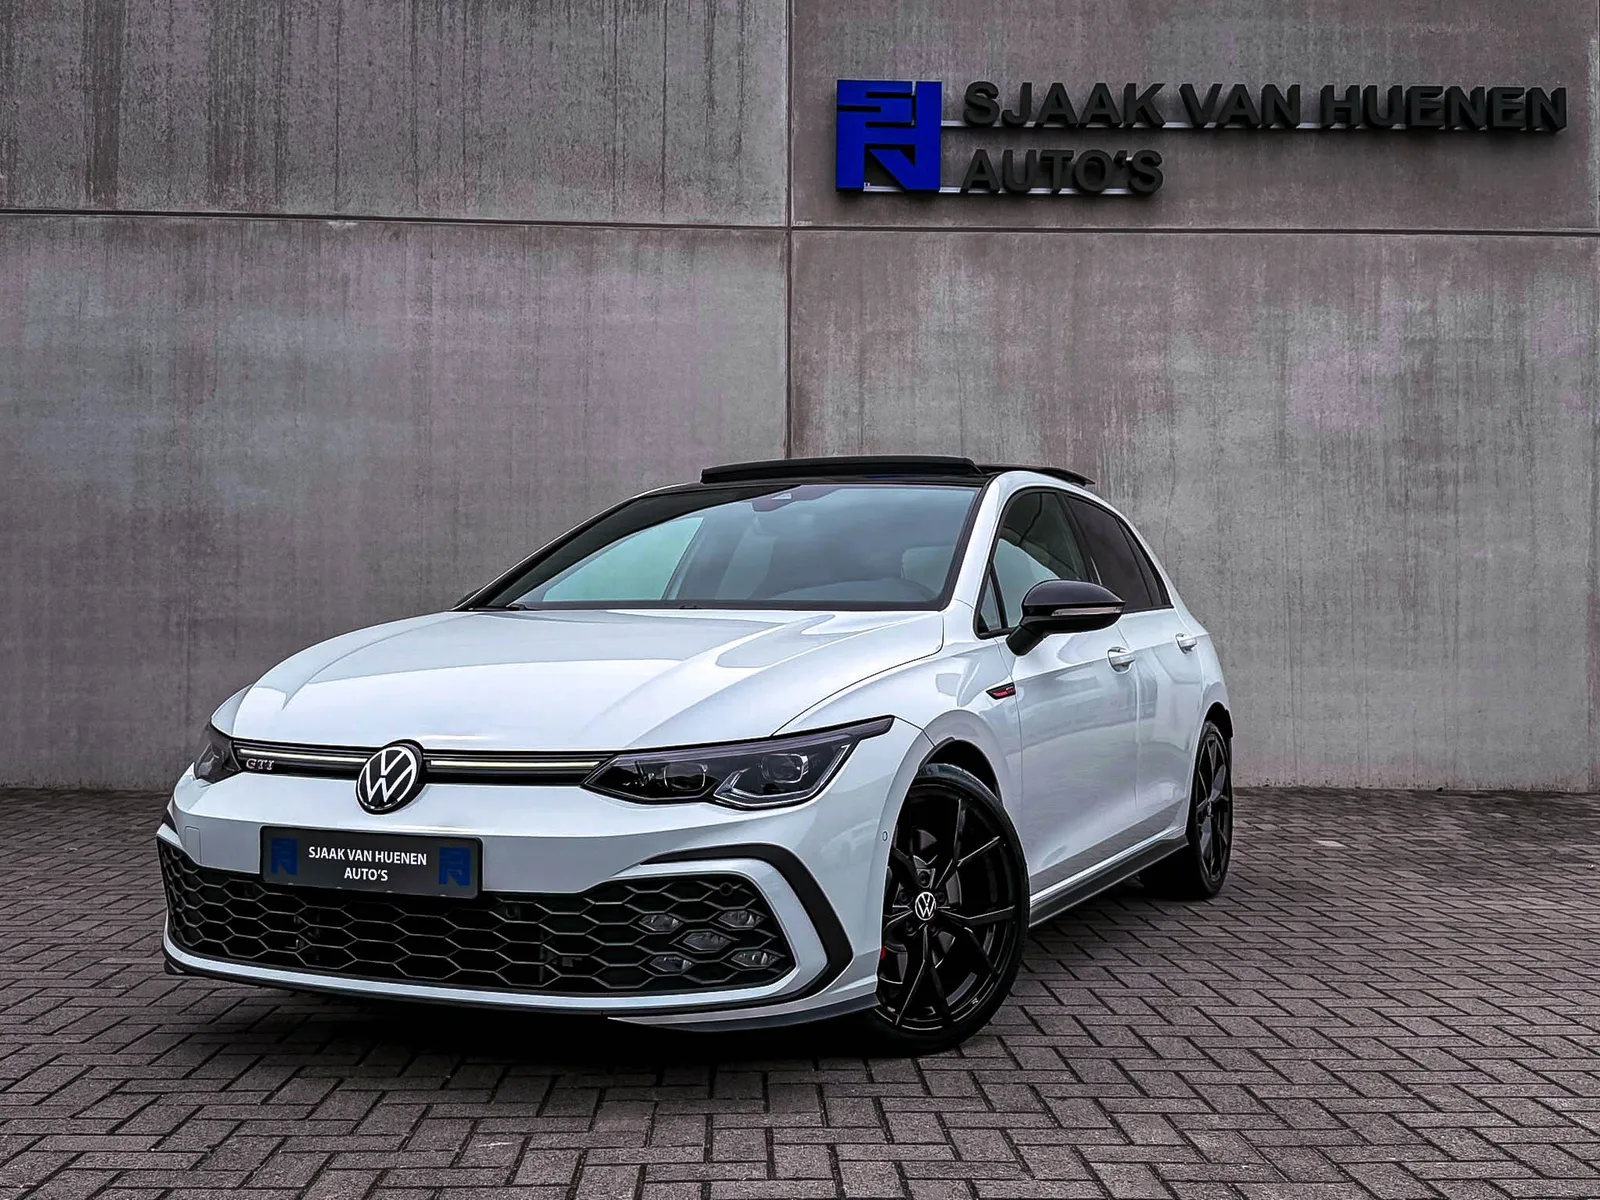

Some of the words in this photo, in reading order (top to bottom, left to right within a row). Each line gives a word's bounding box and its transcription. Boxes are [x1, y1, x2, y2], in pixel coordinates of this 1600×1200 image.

[964, 81, 1165, 128] SJAAK
[1179, 83, 1300, 130] VAN
[1320, 84, 1567, 131] HUENEN
[961, 149, 1164, 194] AUTO'S
[246, 758, 275, 771] GTI
[308, 846, 346, 860] SJAAK
[347, 848, 373, 862] VAN
[375, 850, 428, 866] HUENEN
[343, 867, 389, 881] AUTO'S
